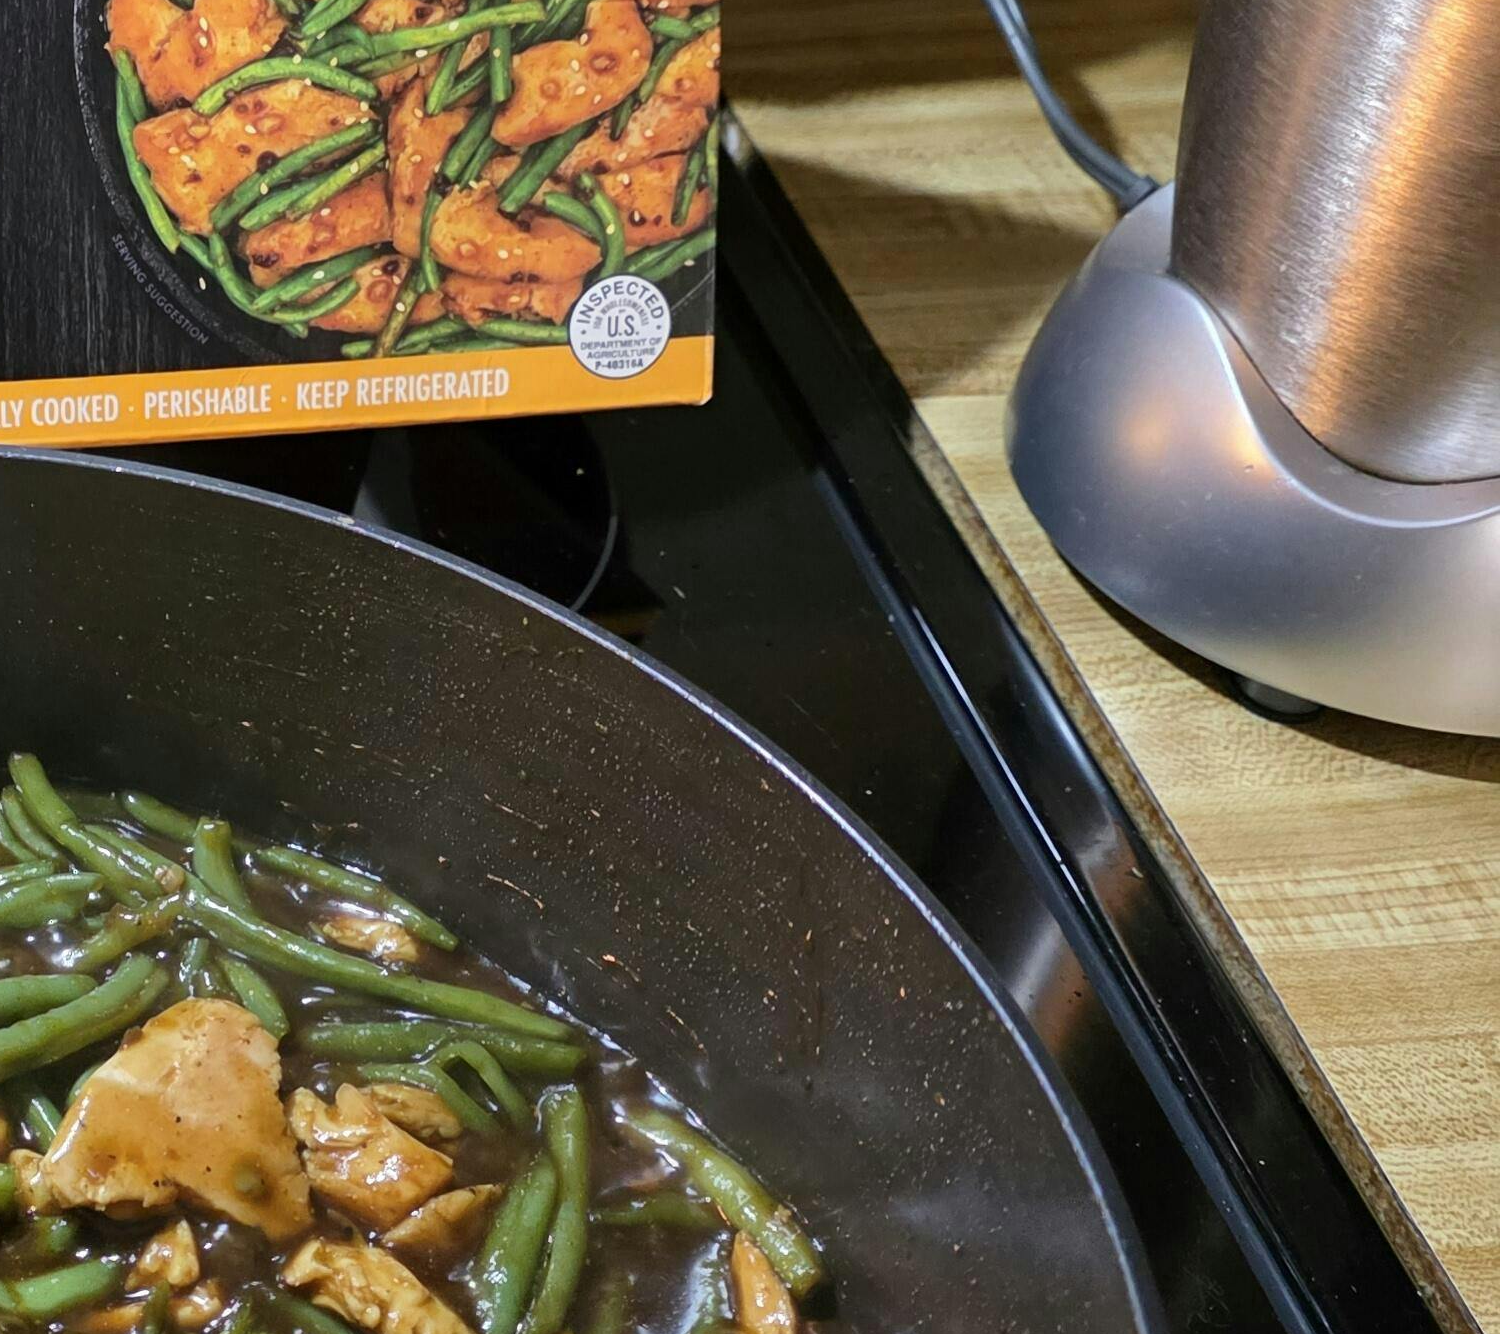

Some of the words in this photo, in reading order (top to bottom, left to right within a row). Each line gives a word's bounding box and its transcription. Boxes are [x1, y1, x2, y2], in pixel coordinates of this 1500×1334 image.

[112, 234, 147, 283] SERVING
[145, 283, 209, 344] SUGGESTION
[576, 280, 664, 324] INSPECTED
[608, 315, 640, 338] U.S.
[31, 394, 119, 427] COOKED
[144, 385, 271, 419] PERISHABLE
[297, 379, 348, 410] KEEP
[356, 368, 509, 406] REFRIGERATED
